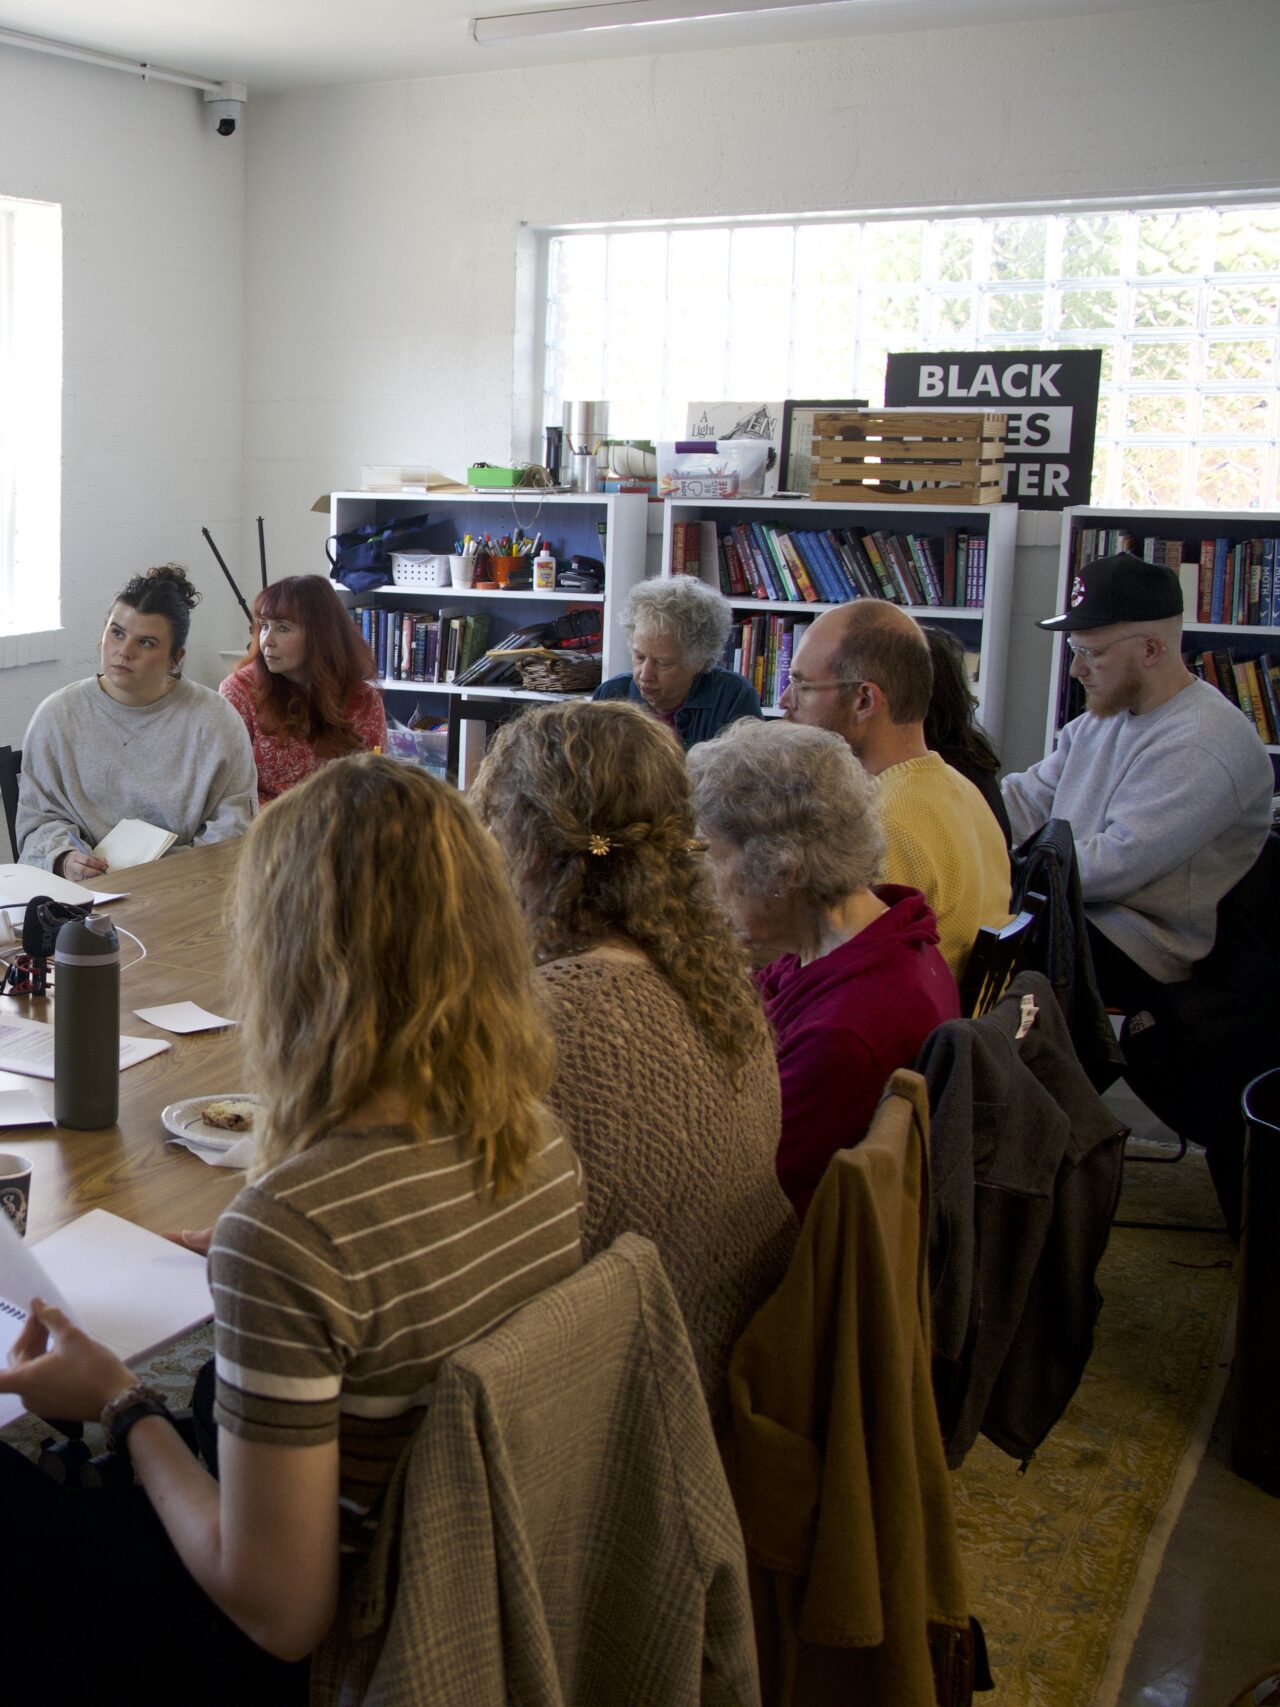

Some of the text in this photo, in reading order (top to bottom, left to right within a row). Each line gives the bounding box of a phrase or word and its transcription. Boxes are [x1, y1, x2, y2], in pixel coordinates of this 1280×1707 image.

[918, 364, 1063, 398] BLACK
[691, 423, 715, 438] Light
[1262, 566, 1270, 595] MOTH
